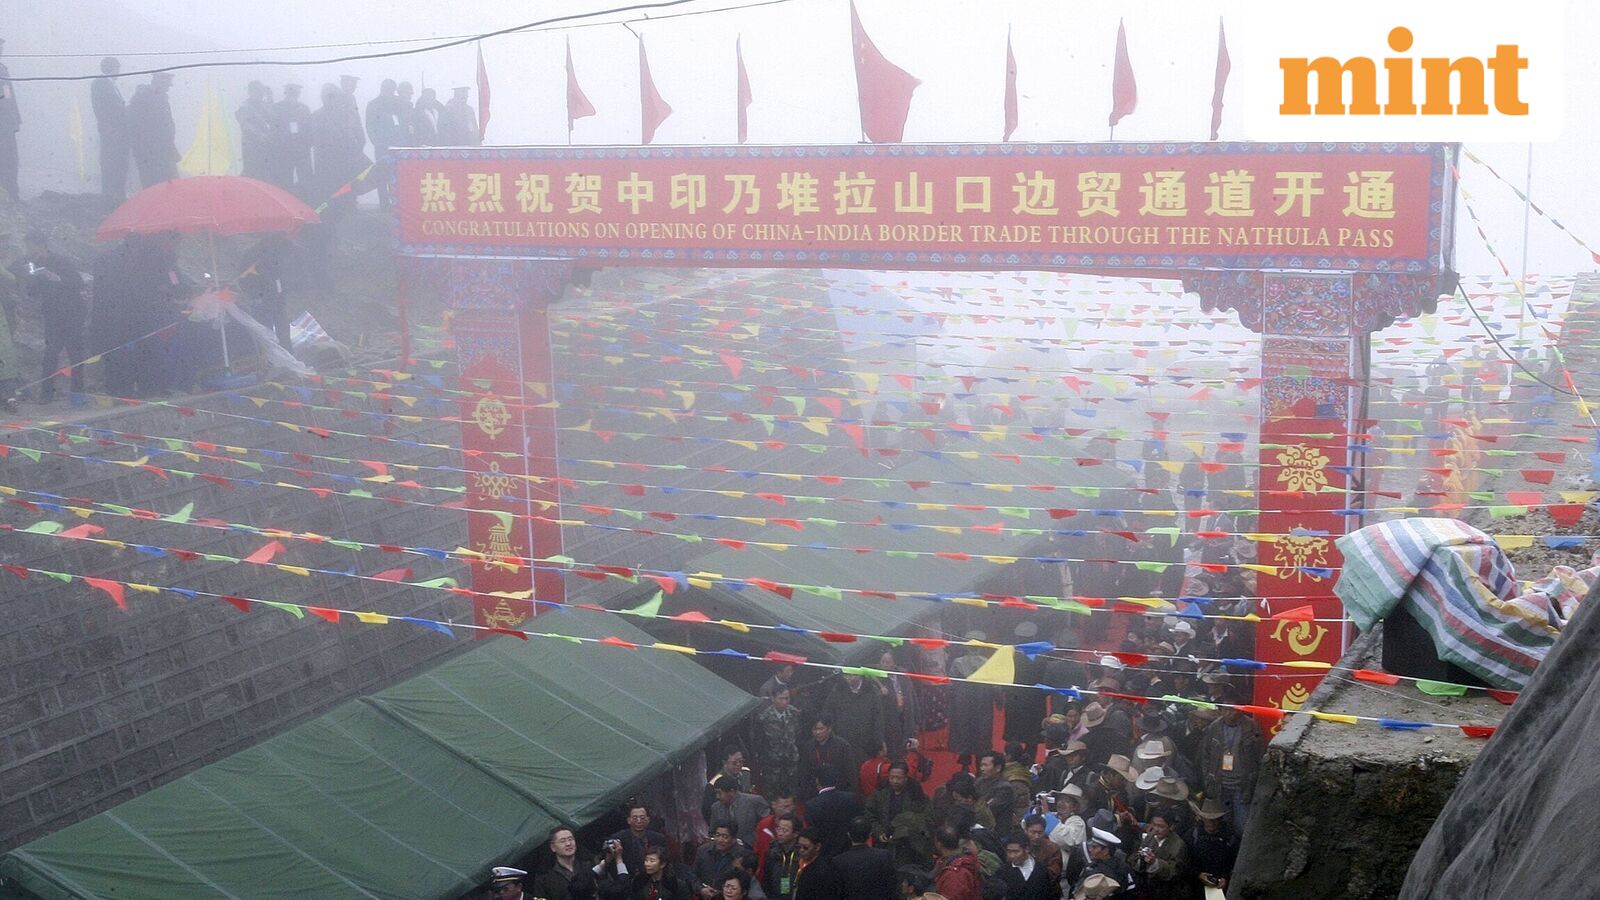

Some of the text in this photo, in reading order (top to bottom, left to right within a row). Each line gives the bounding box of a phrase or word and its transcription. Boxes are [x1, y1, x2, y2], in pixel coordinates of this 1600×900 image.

[421, 169, 1396, 219] 热烈祝贺中印乃堆拉山口边贸通道开通
[421, 220, 591, 240] CONGRATULATIONS
[595, 221, 620, 240] ON
[625, 222, 707, 241] OPENING
[712, 223, 736, 241] OF
[878, 224, 964, 243] BORDER
[969, 224, 1041, 245] TRADE
[1048, 225, 1160, 246] THROUGH
[1166, 227, 1211, 246] THE
[1217, 227, 1331, 248] NATHULA
[1338, 228, 1395, 249] PASS
